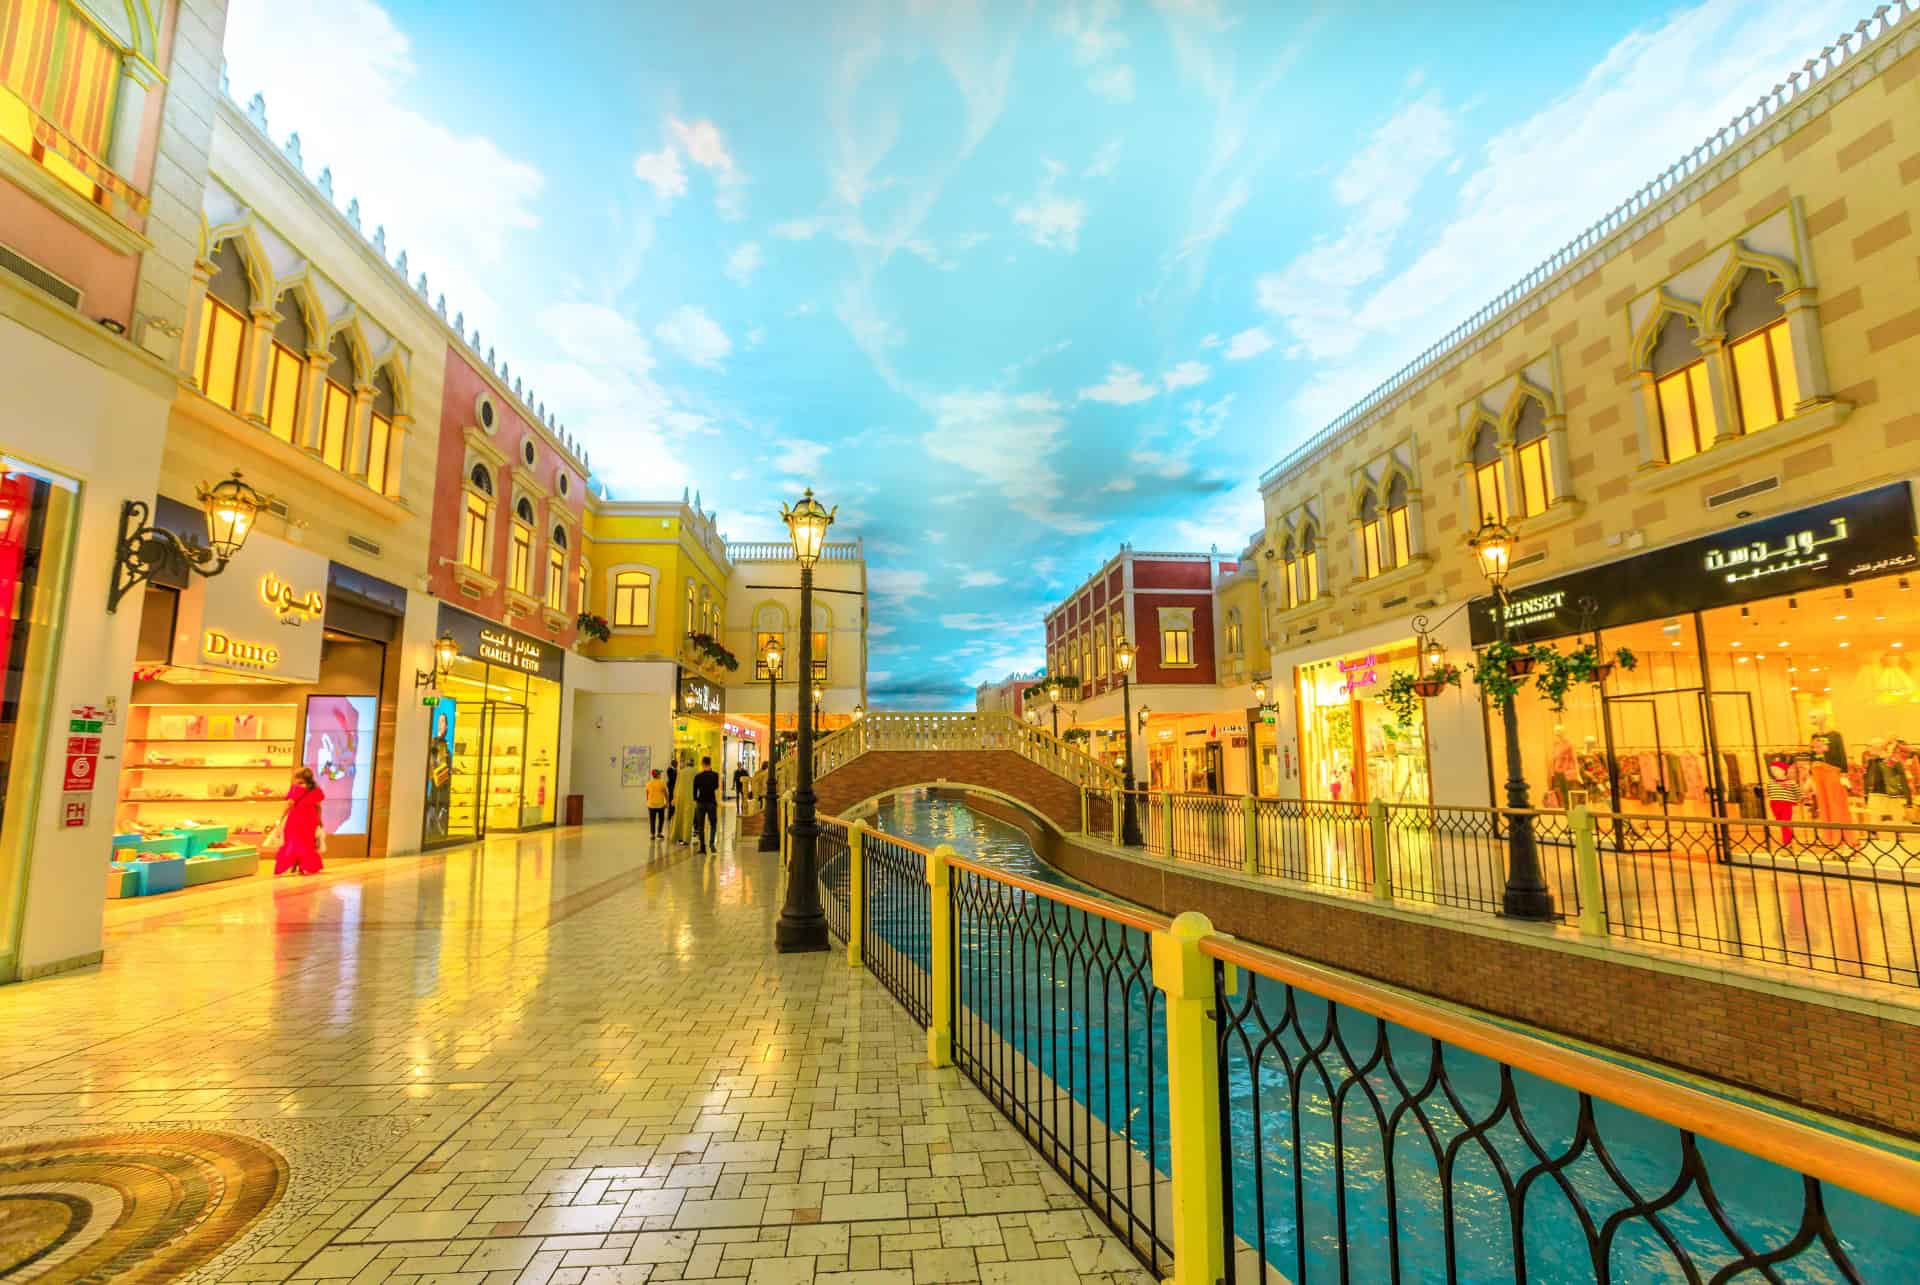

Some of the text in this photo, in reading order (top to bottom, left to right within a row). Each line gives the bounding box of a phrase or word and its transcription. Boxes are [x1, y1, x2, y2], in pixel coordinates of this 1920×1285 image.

[260, 573, 323, 617] ديون
[205, 632, 279, 665] Dune
[479, 643, 511, 664] CHARLES
[521, 656, 539, 672] KEITH
